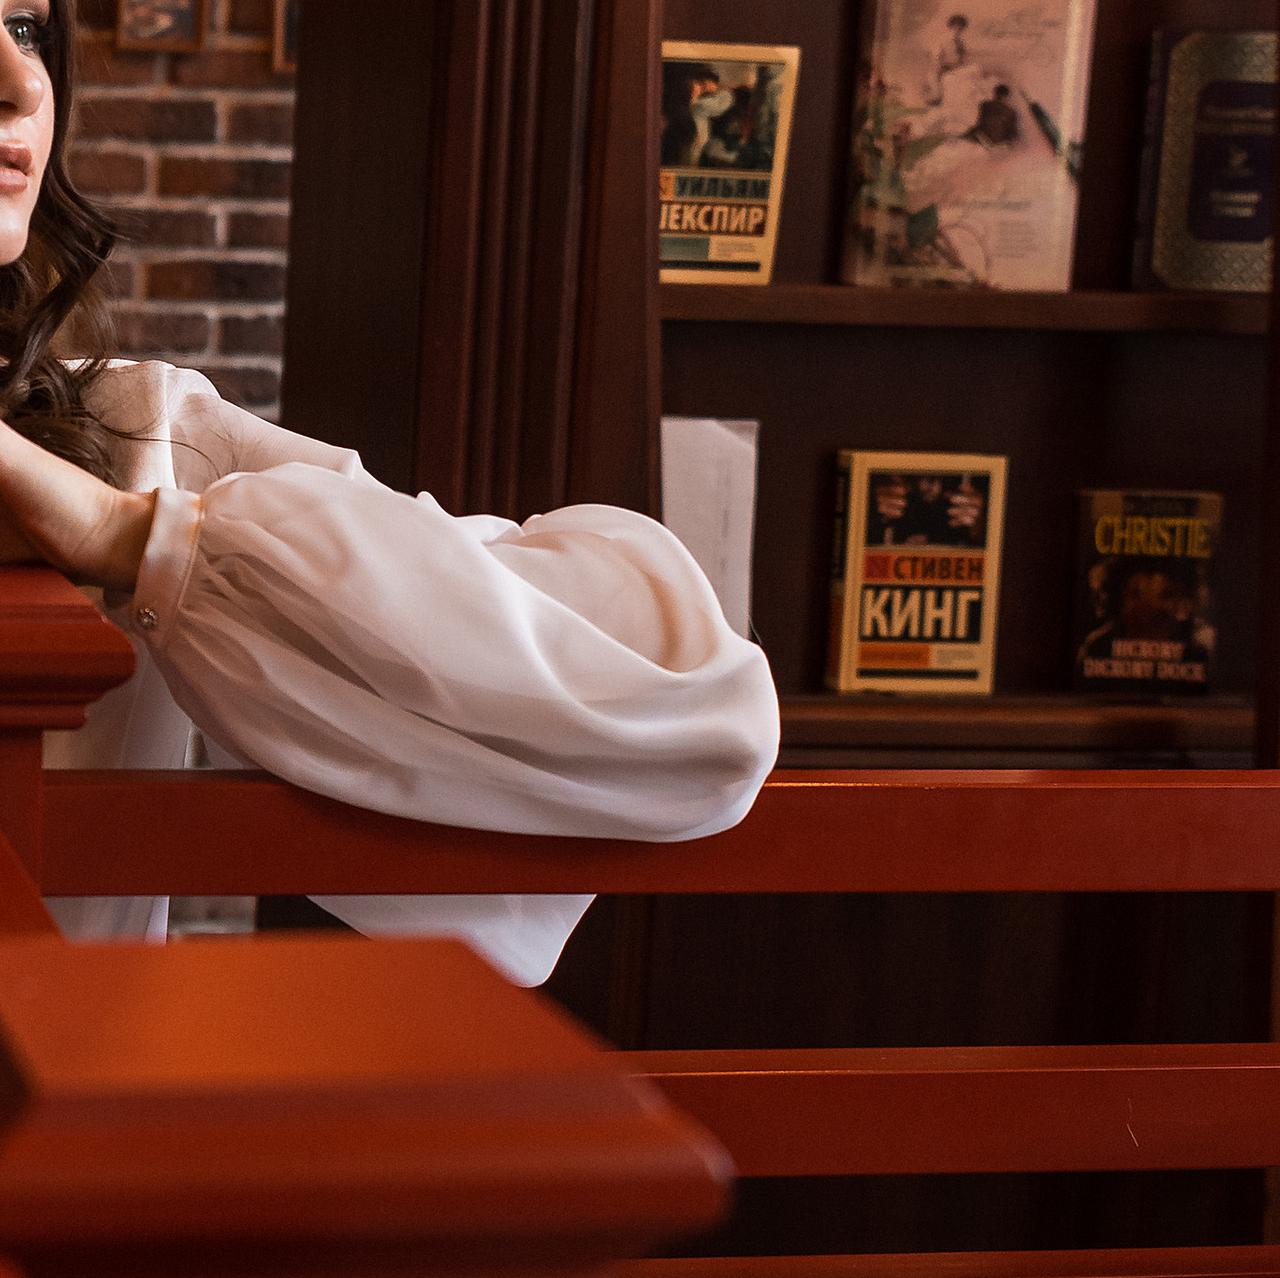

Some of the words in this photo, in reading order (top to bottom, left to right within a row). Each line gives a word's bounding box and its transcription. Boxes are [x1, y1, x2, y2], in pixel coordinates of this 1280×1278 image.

[675, 175, 770, 200] УИЛЬЯМ
[1094, 514, 1213, 559] CHRISTIE
[892, 554, 985, 581] СТИВЕН
[862, 587, 981, 640] КИНГ
